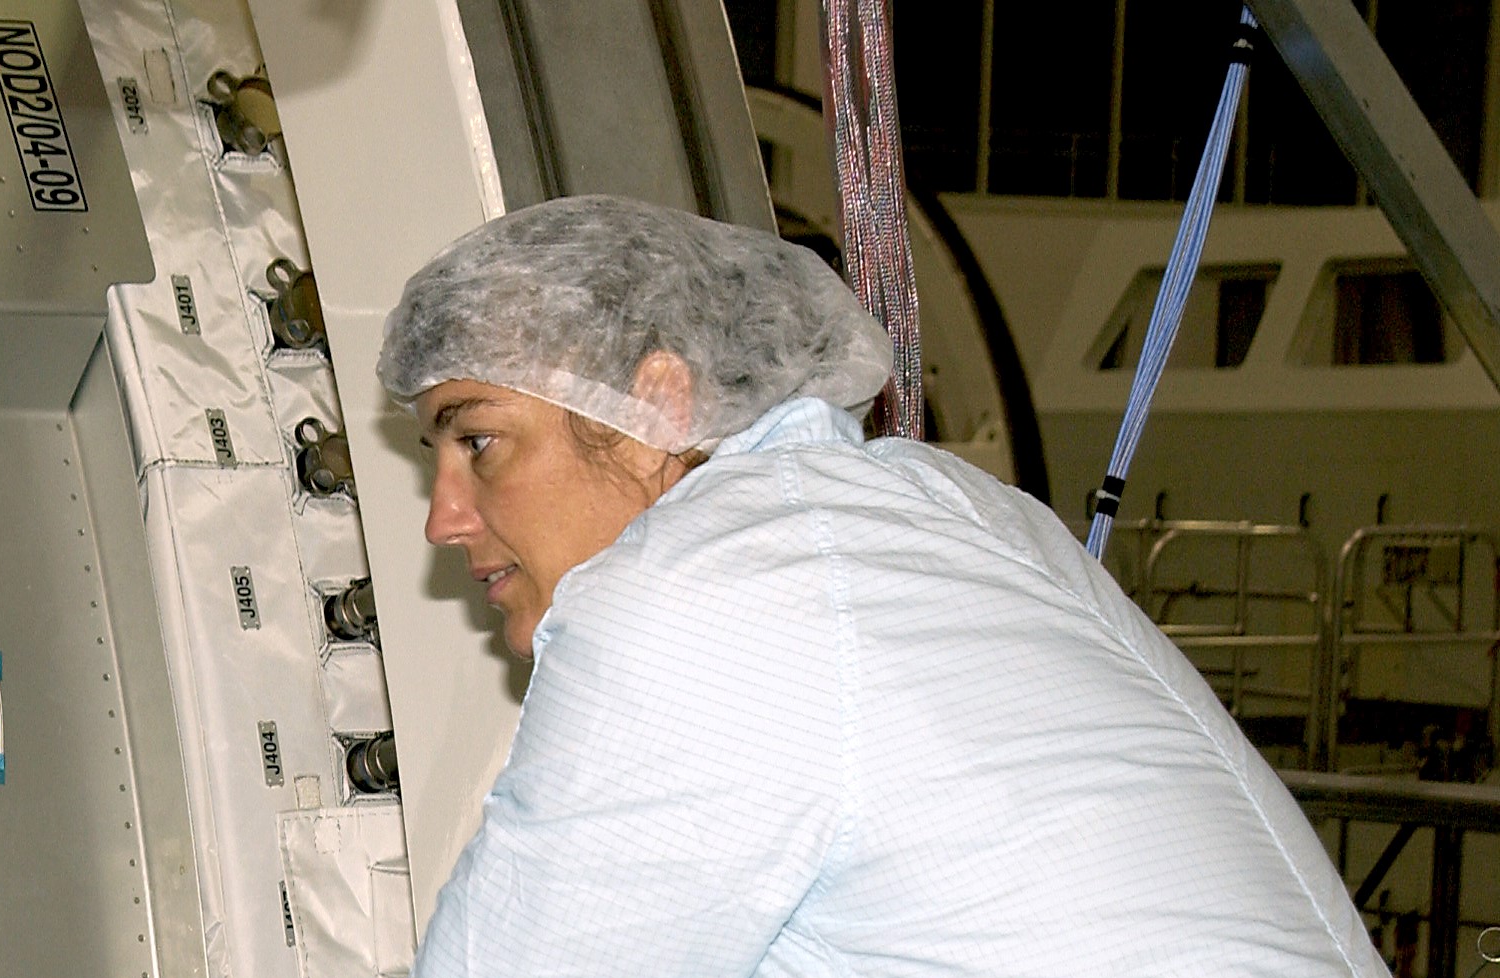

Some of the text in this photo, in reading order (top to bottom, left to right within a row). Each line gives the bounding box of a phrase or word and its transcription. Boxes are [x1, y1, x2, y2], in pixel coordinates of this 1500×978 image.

[122, 86, 144, 125] J402
[176, 286, 196, 325] J401
[210, 418, 232, 458] J403
[235, 576, 255, 618] J405
[262, 731, 280, 775] J404
